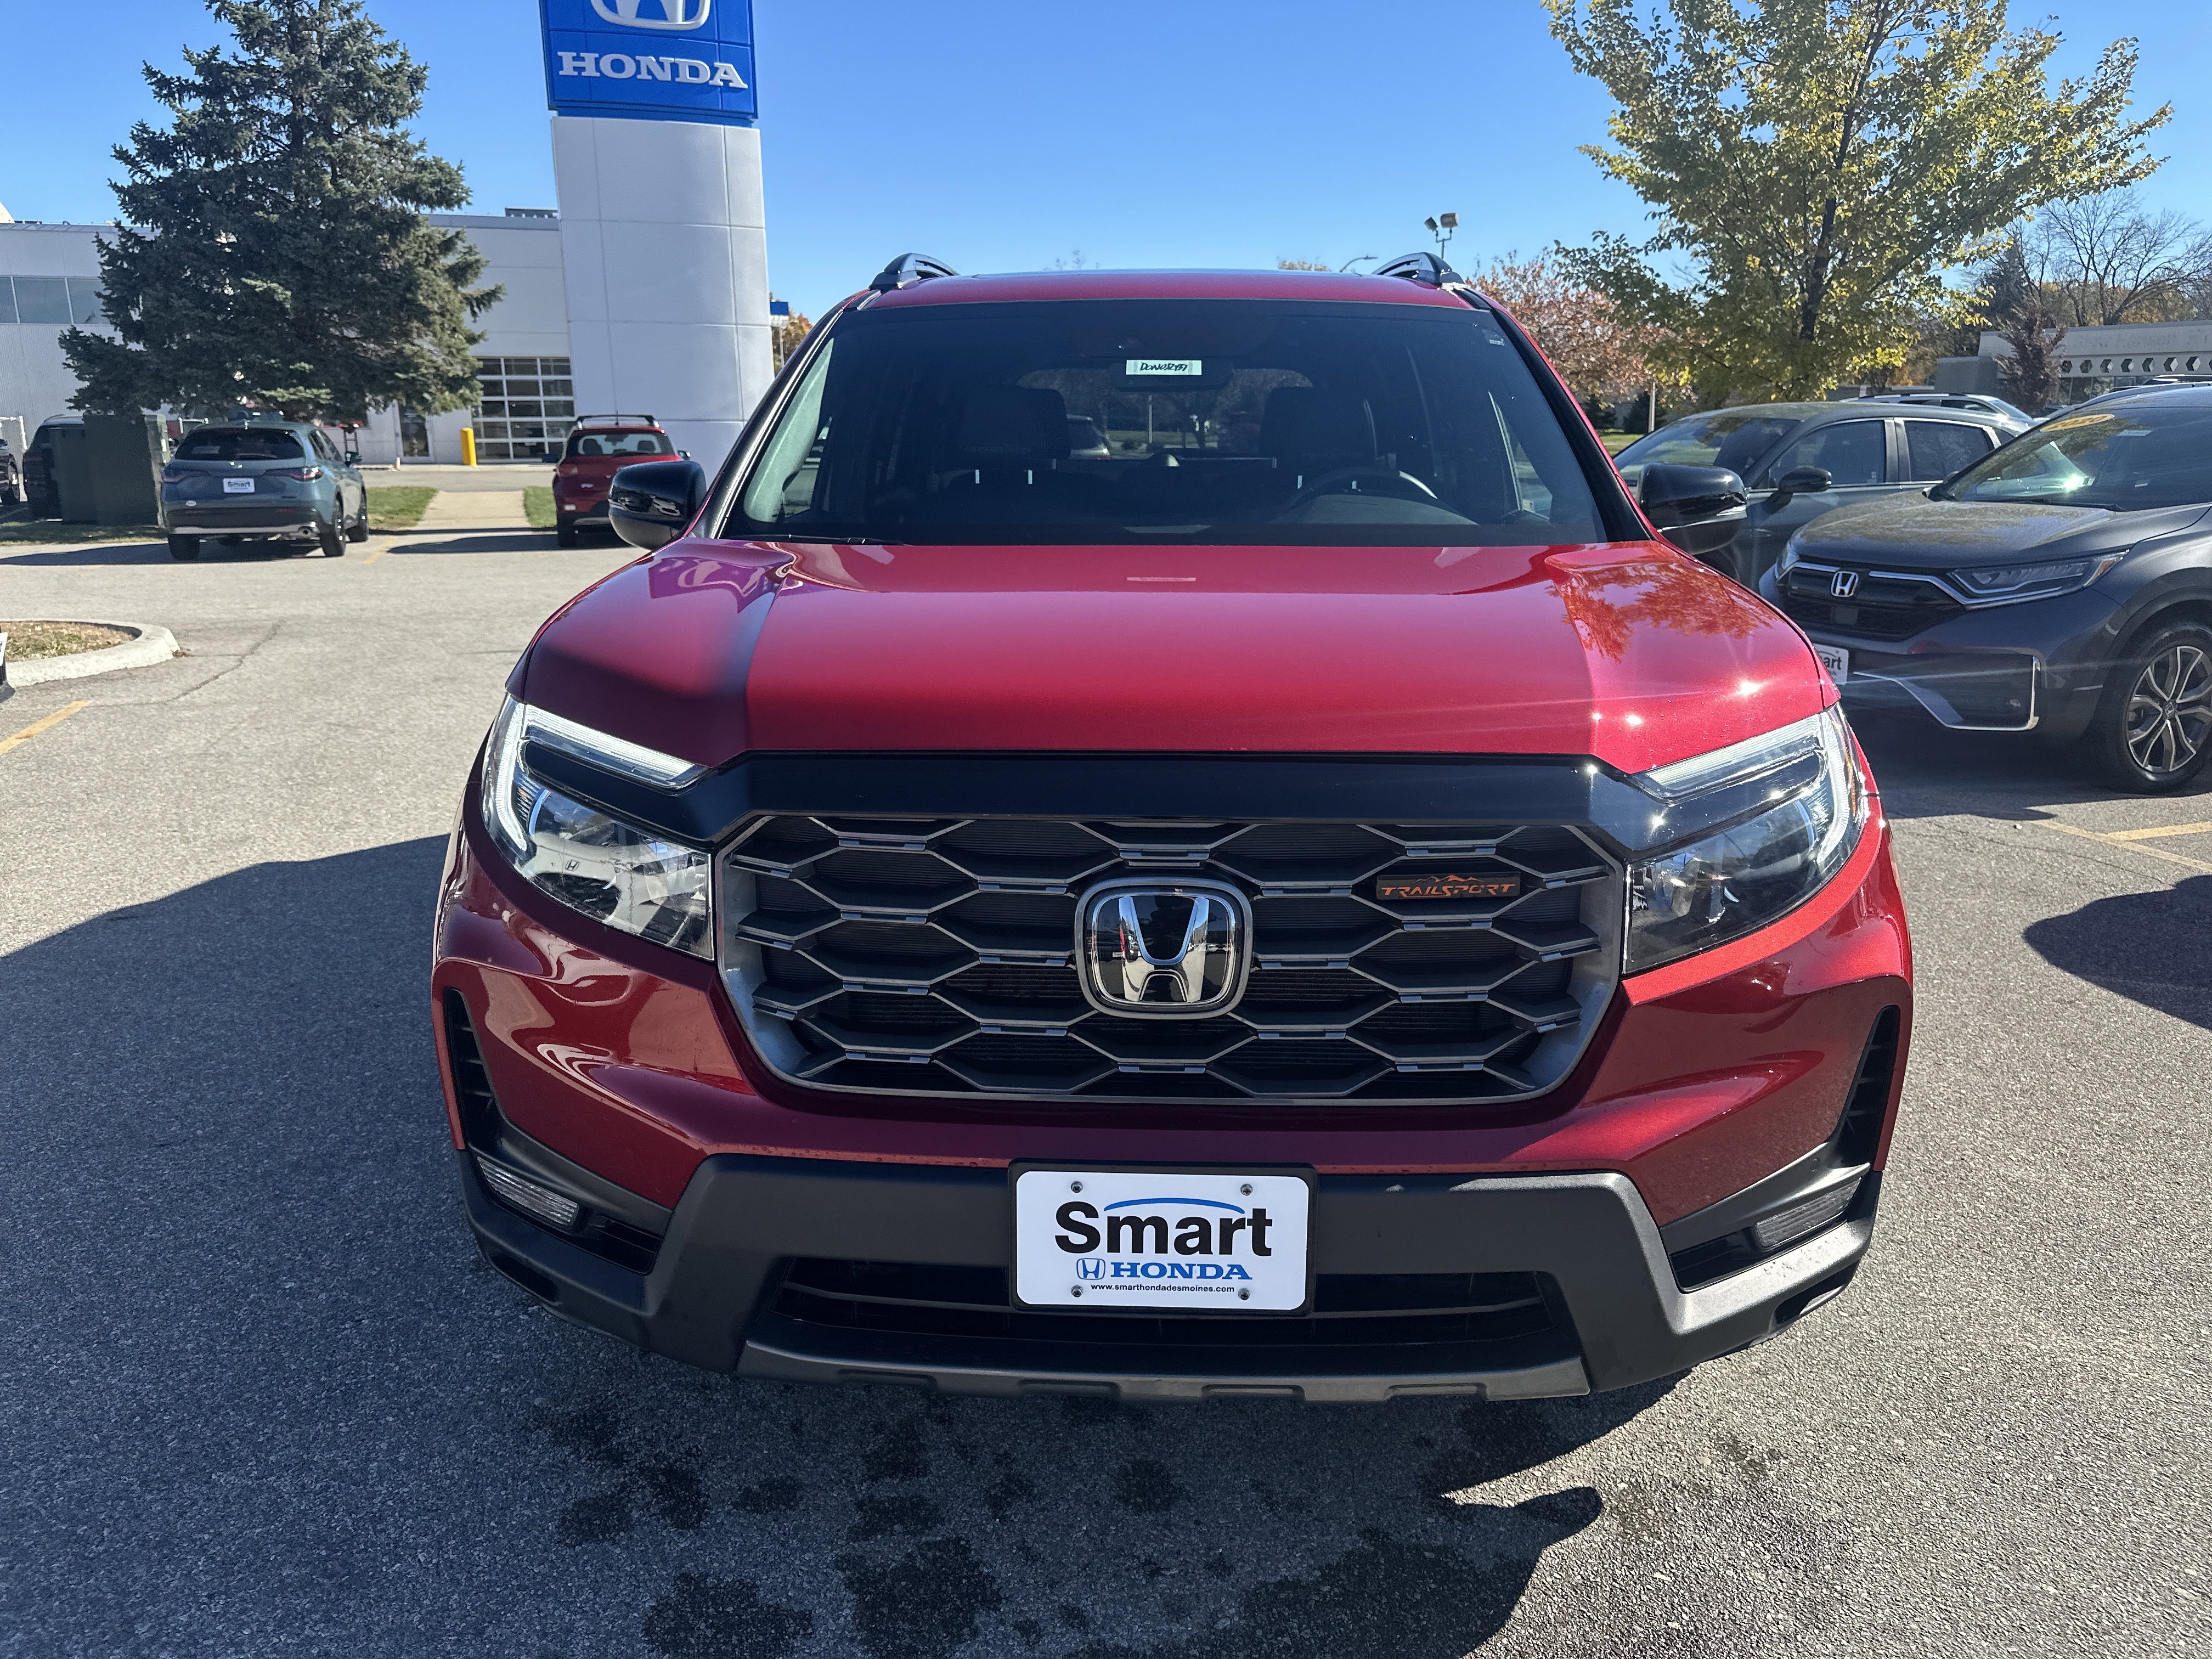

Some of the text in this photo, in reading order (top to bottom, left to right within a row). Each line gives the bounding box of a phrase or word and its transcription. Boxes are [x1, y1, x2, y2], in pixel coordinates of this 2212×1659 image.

[557, 52, 748, 89] HONDA
[1823, 656, 1842, 670] art
[1381, 884, 1516, 899] TRAILSPORT
[1054, 1201, 1273, 1257] Smart
[1111, 1262, 1253, 1280] HONDA
[1091, 1283, 1235, 1293] www.smarthondadesmoines.com
